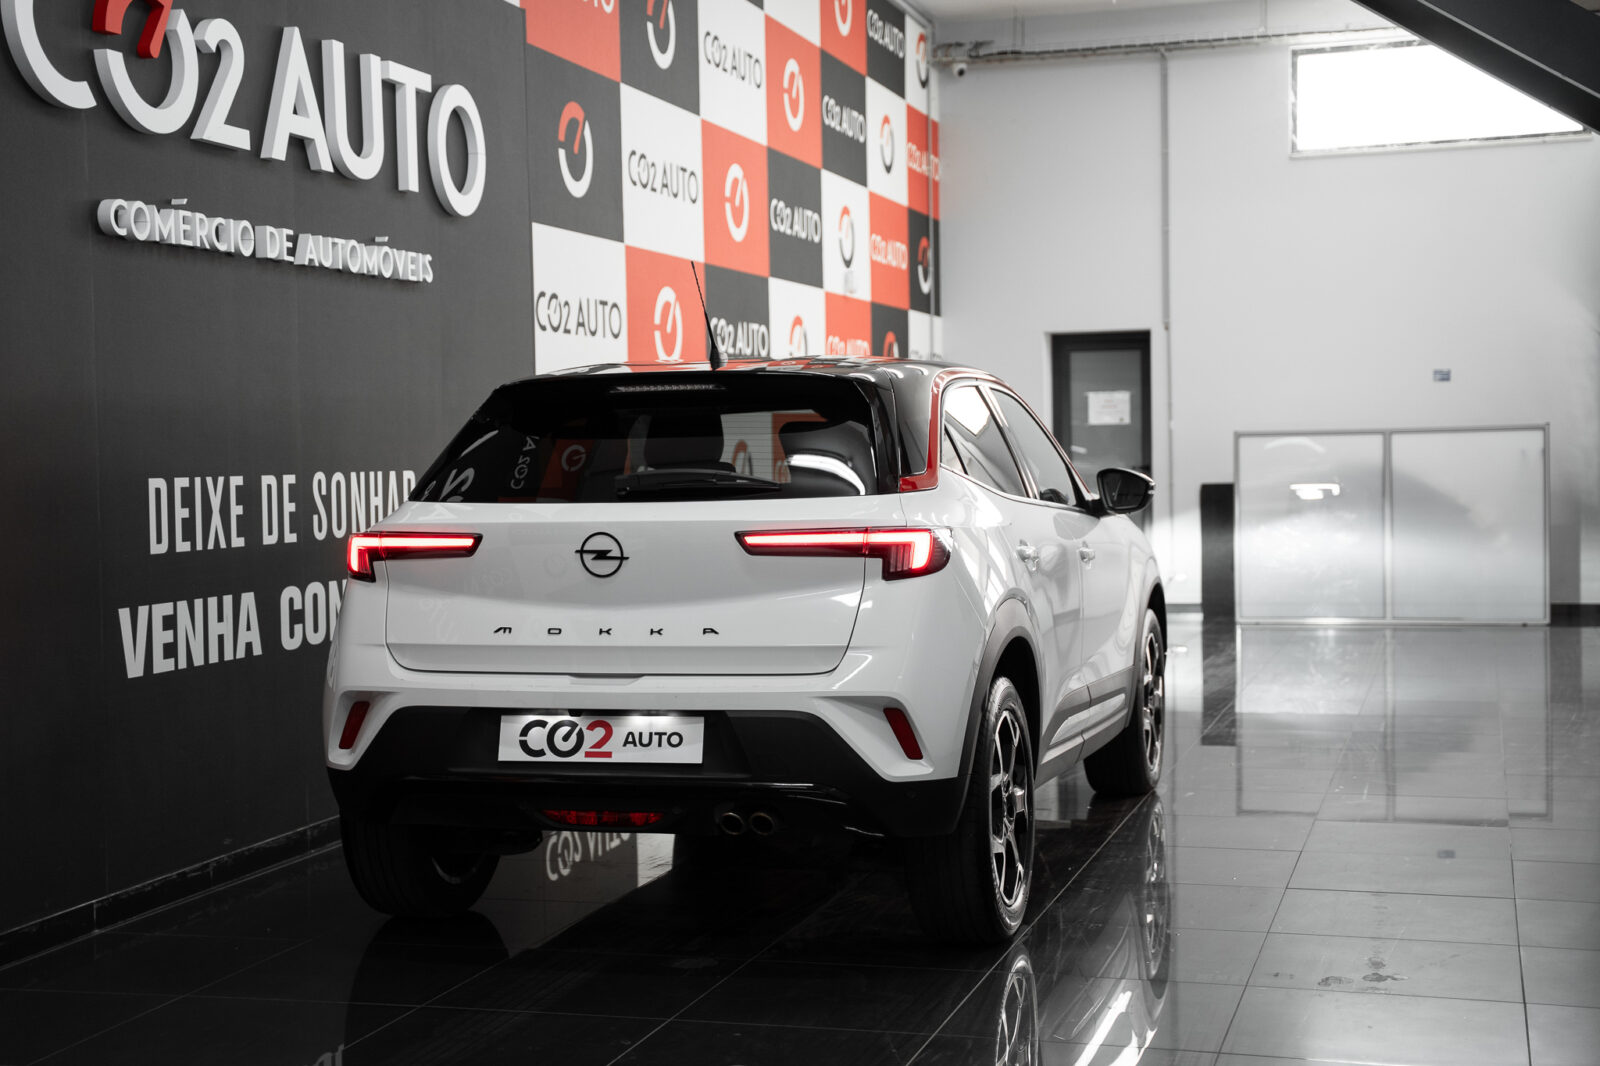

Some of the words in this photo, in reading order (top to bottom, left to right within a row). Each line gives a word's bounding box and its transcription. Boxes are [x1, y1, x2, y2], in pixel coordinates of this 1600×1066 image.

[703, 31, 728, 73] CO2
[730, 45, 762, 89] AUTO
[259, 26, 487, 217] AUTO
[628, 150, 657, 193] CO2
[660, 160, 698, 204] AUTO
[97, 198, 255, 257] COMÉRCIO
[255, 225, 295, 262] DE
[294, 236, 433, 283] AUTOMÓVEIS
[791, 205, 822, 244] AUTO
[535, 291, 571, 335] CO2
[575, 297, 622, 339] AUTO
[736, 320, 769, 358] AUTO
[148, 475, 245, 555] DEIXE
[260, 474, 298, 546] DE
[118, 591, 263, 679] VENHA
[493, 626, 719, 636] MOKKA
[518, 719, 614, 759] CO2
[622, 731, 684, 748] AUTO
